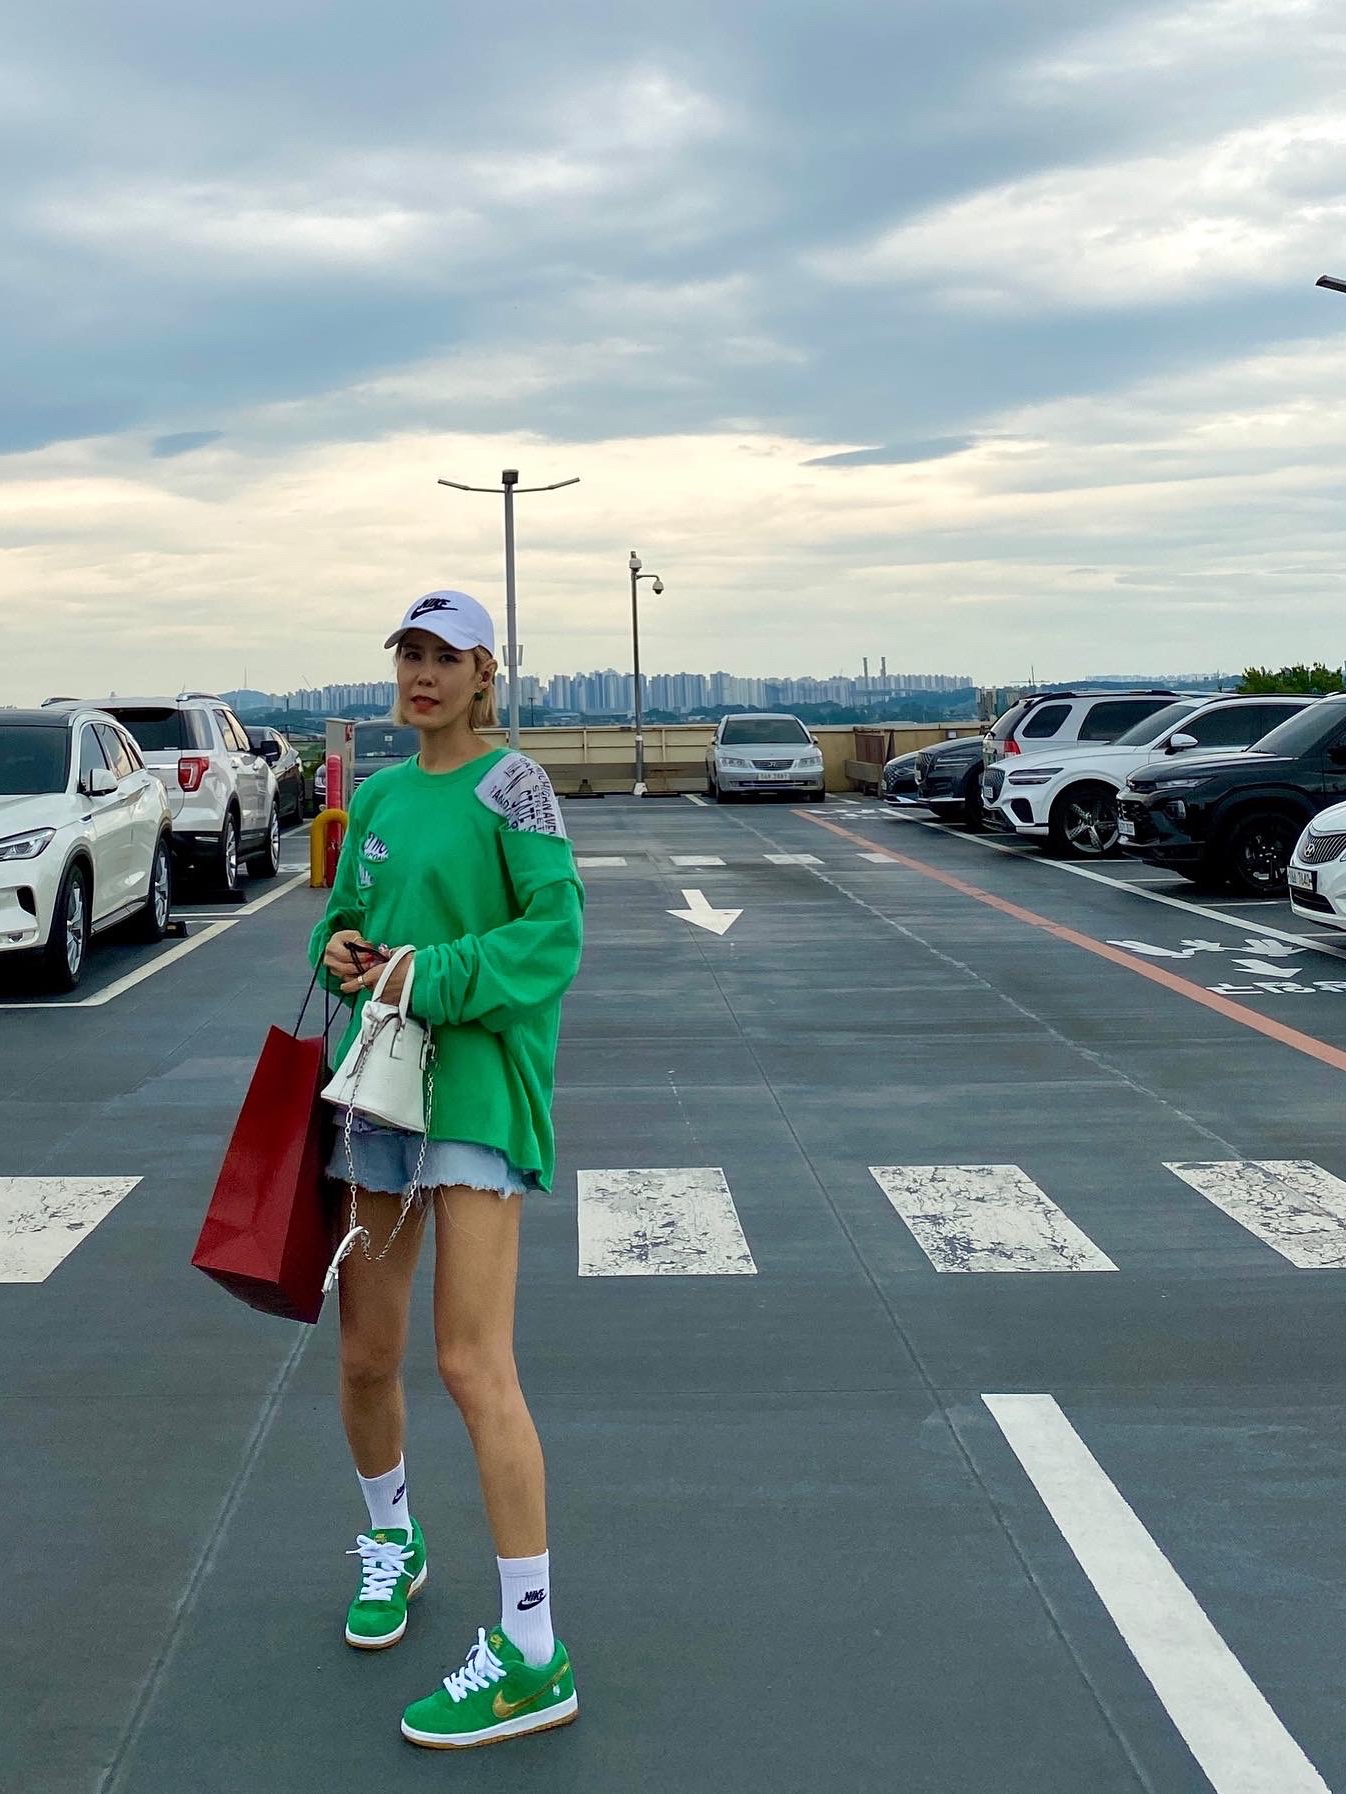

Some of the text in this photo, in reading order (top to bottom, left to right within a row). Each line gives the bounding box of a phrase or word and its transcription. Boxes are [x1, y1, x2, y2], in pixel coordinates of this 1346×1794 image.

[420, 597, 451, 608] NIKE
[532, 784, 546, 832] STREET
[542, 812, 557, 835] AVE
[524, 1588, 544, 1601] NIKE
